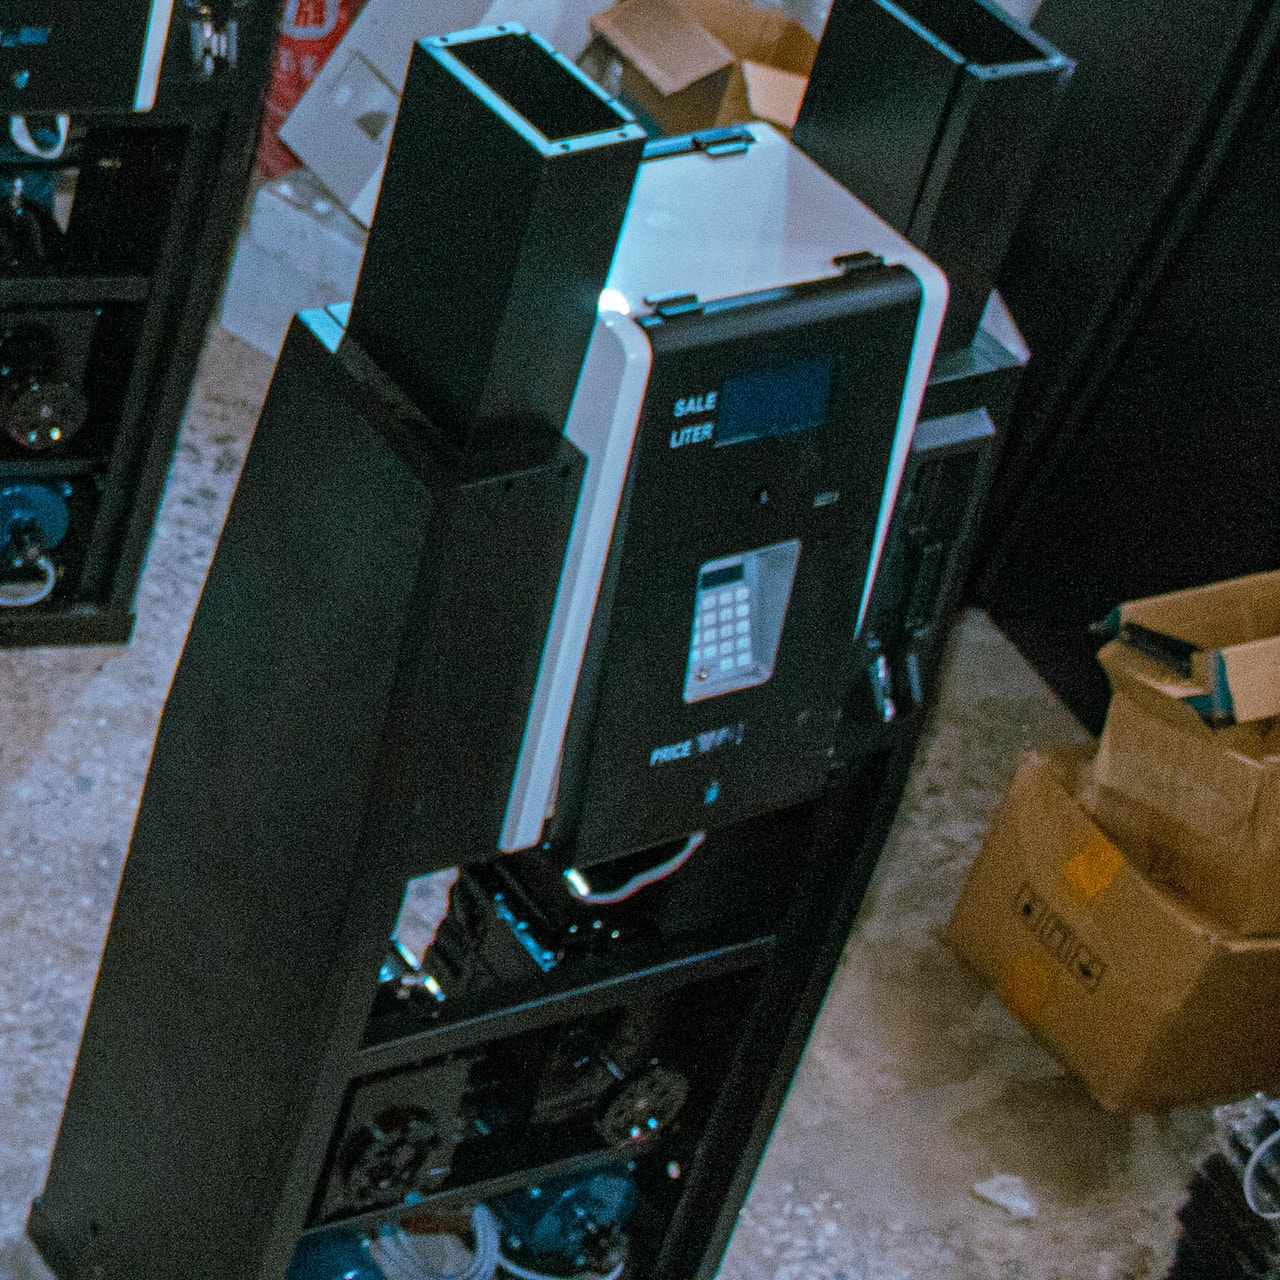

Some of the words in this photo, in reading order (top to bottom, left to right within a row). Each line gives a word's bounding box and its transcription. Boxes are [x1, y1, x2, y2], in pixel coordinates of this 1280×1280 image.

[673, 391, 717, 418] SALE
[668, 421, 714, 449] LITER
[648, 738, 692, 767] PRICE
